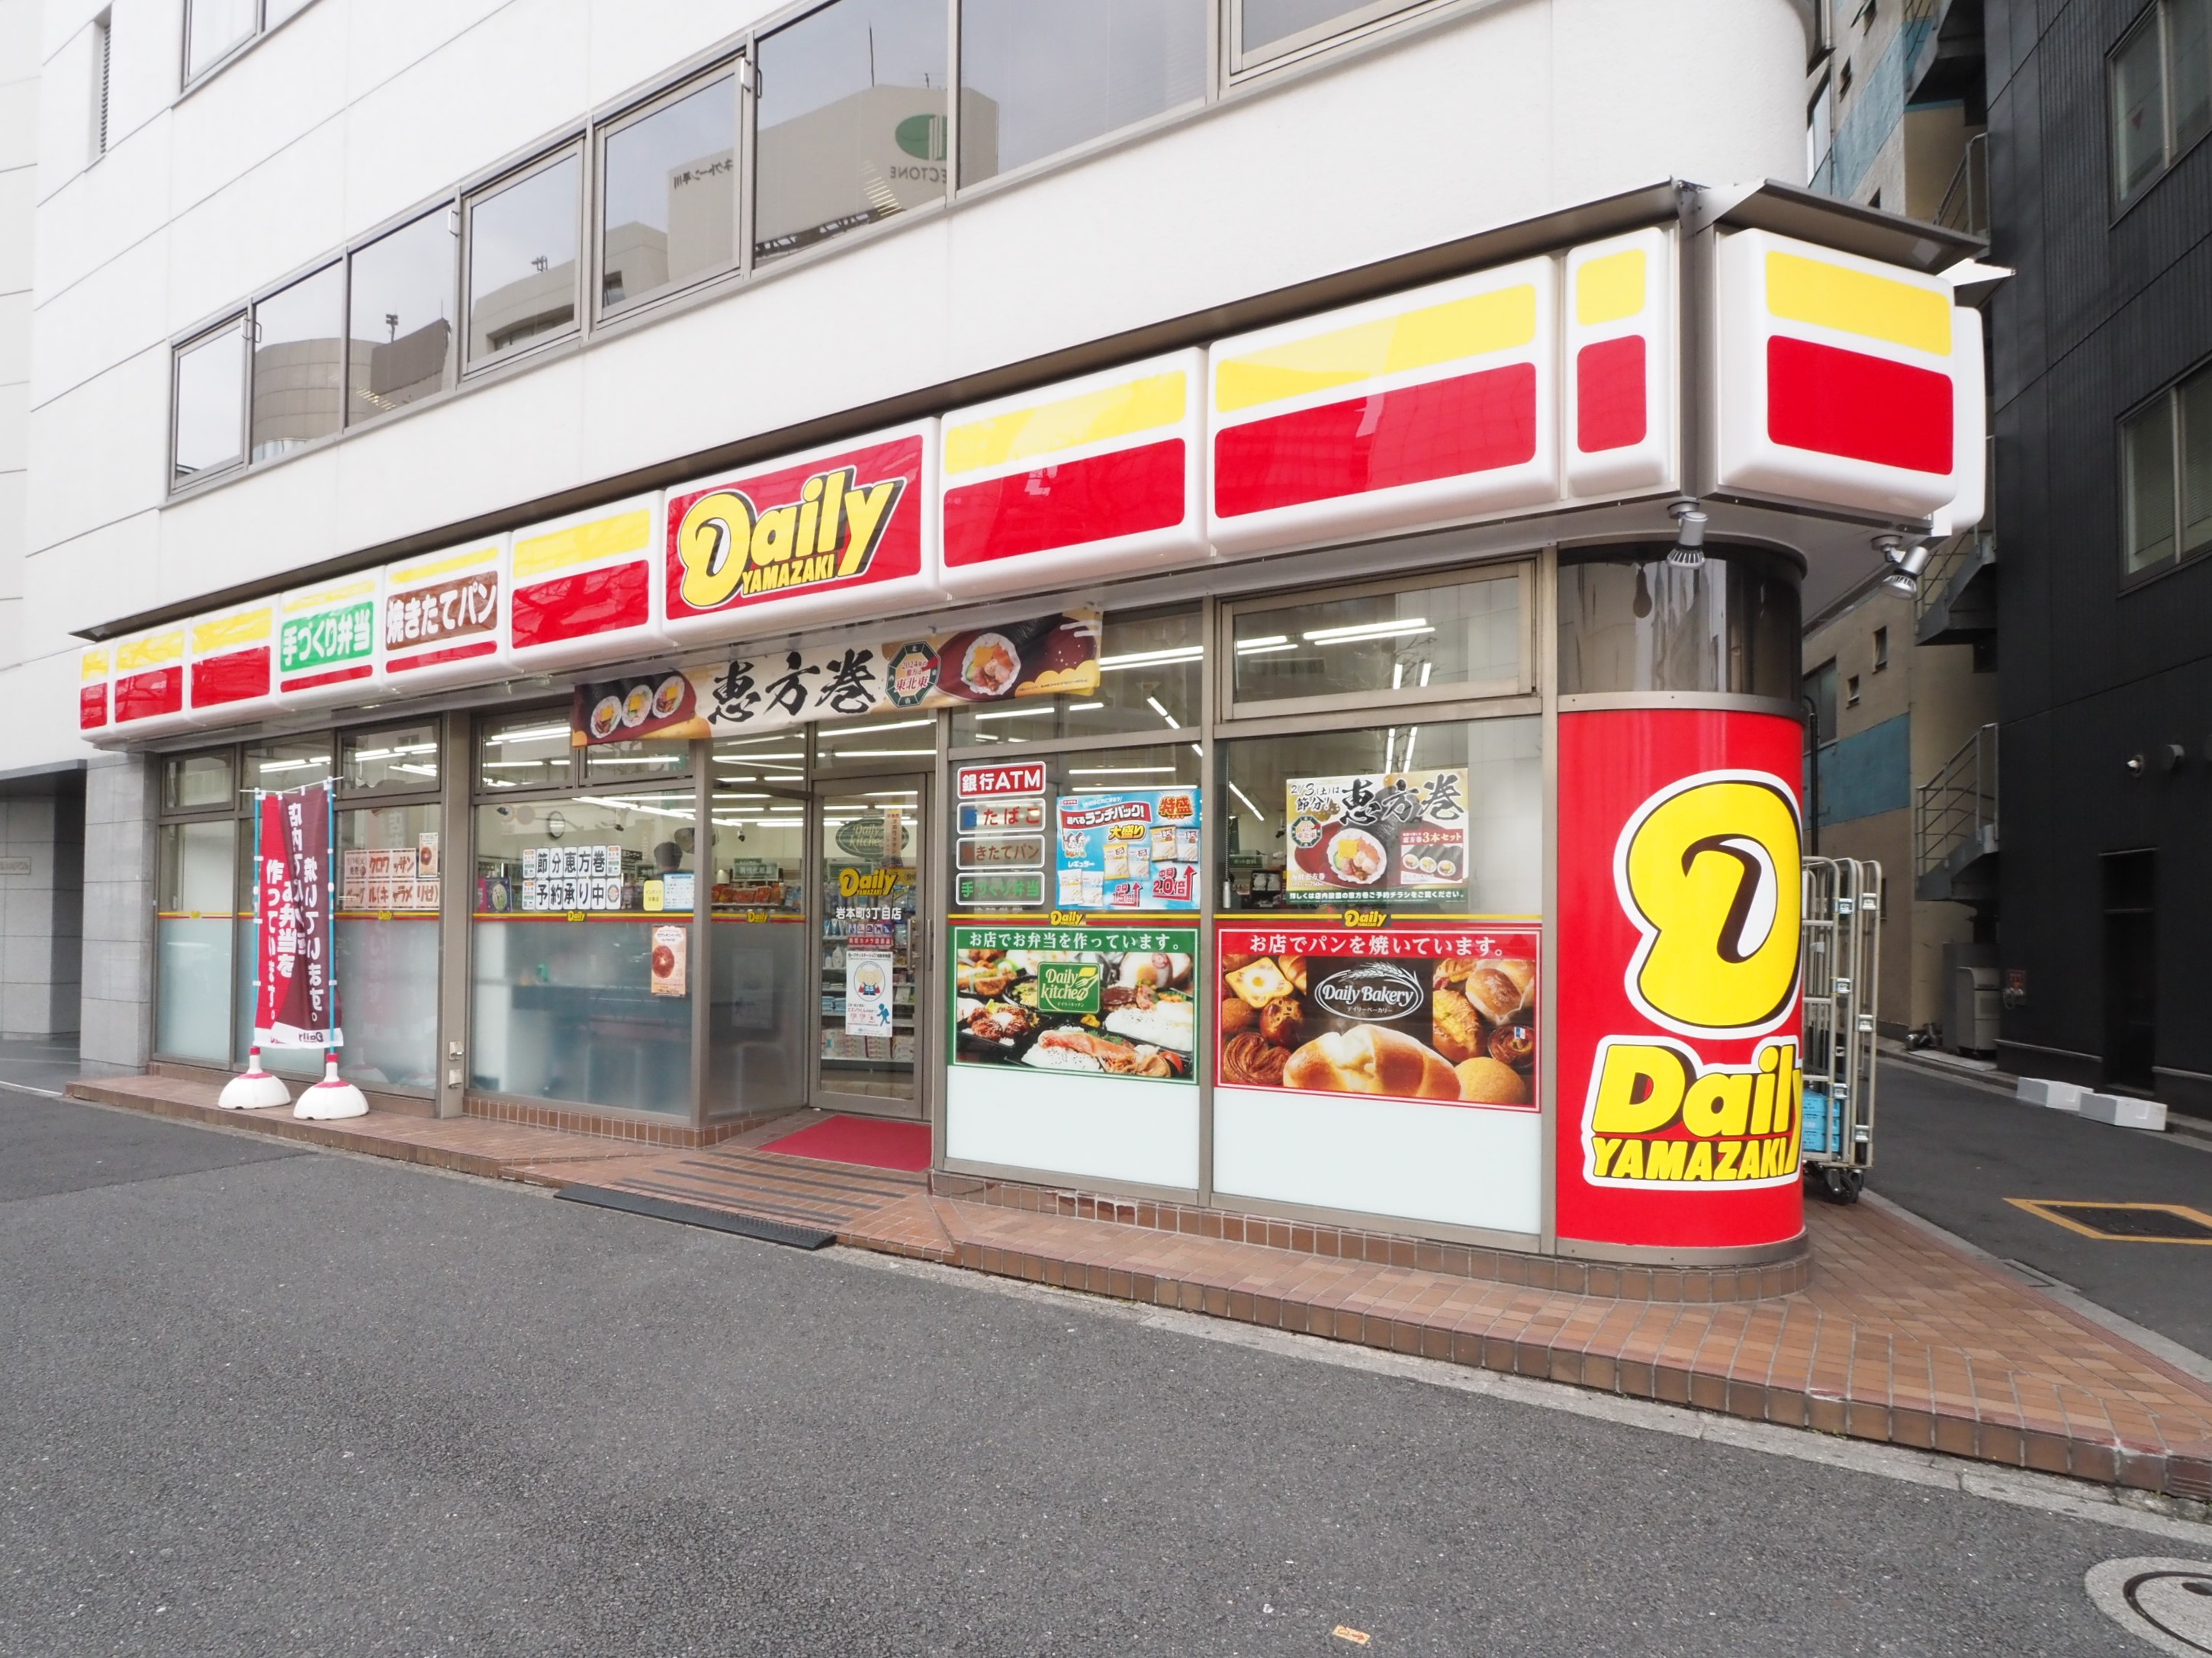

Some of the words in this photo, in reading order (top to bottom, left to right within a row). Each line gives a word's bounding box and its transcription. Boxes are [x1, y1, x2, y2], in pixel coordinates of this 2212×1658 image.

[679, 468, 906, 606] Daily
[742, 554, 838, 595] YAMAZAKI
[387, 581, 497, 644] 焼きたてパン
[282, 608, 371, 667] 手づくり弁当
[708, 647, 877, 725] 恵方巻
[896, 676, 929, 691] 東北東
[961, 768, 1041, 792] 銀行ATM
[1159, 795, 1194, 817] 特盛
[1339, 773, 1464, 826] 恵方巻
[849, 834, 885, 847] kitche
[1108, 824, 1145, 840] 大盛り
[1422, 832, 1462, 843] 3本セット
[537, 850, 606, 874] 節分恵方巻
[536, 882, 604, 906] 予約承り中
[840, 868, 898, 897] Daily
[961, 879, 1040, 898] 手づくり弁当
[836, 906, 902, 920] 岩本町3丁目店
[1050, 911, 1083, 925] Daily
[1344, 910, 1387, 927] Daily
[969, 931, 1178, 950] お店でお弁当を作っています。
[1249, 934, 1503, 957] お店でパンを焼いています。
[1046, 969, 1079, 988] Daily
[1322, 984, 1361, 1004] Daily
[1362, 985, 1414, 1007] Bakery
[1592, 1136, 1787, 1181] YAMAZAKI
